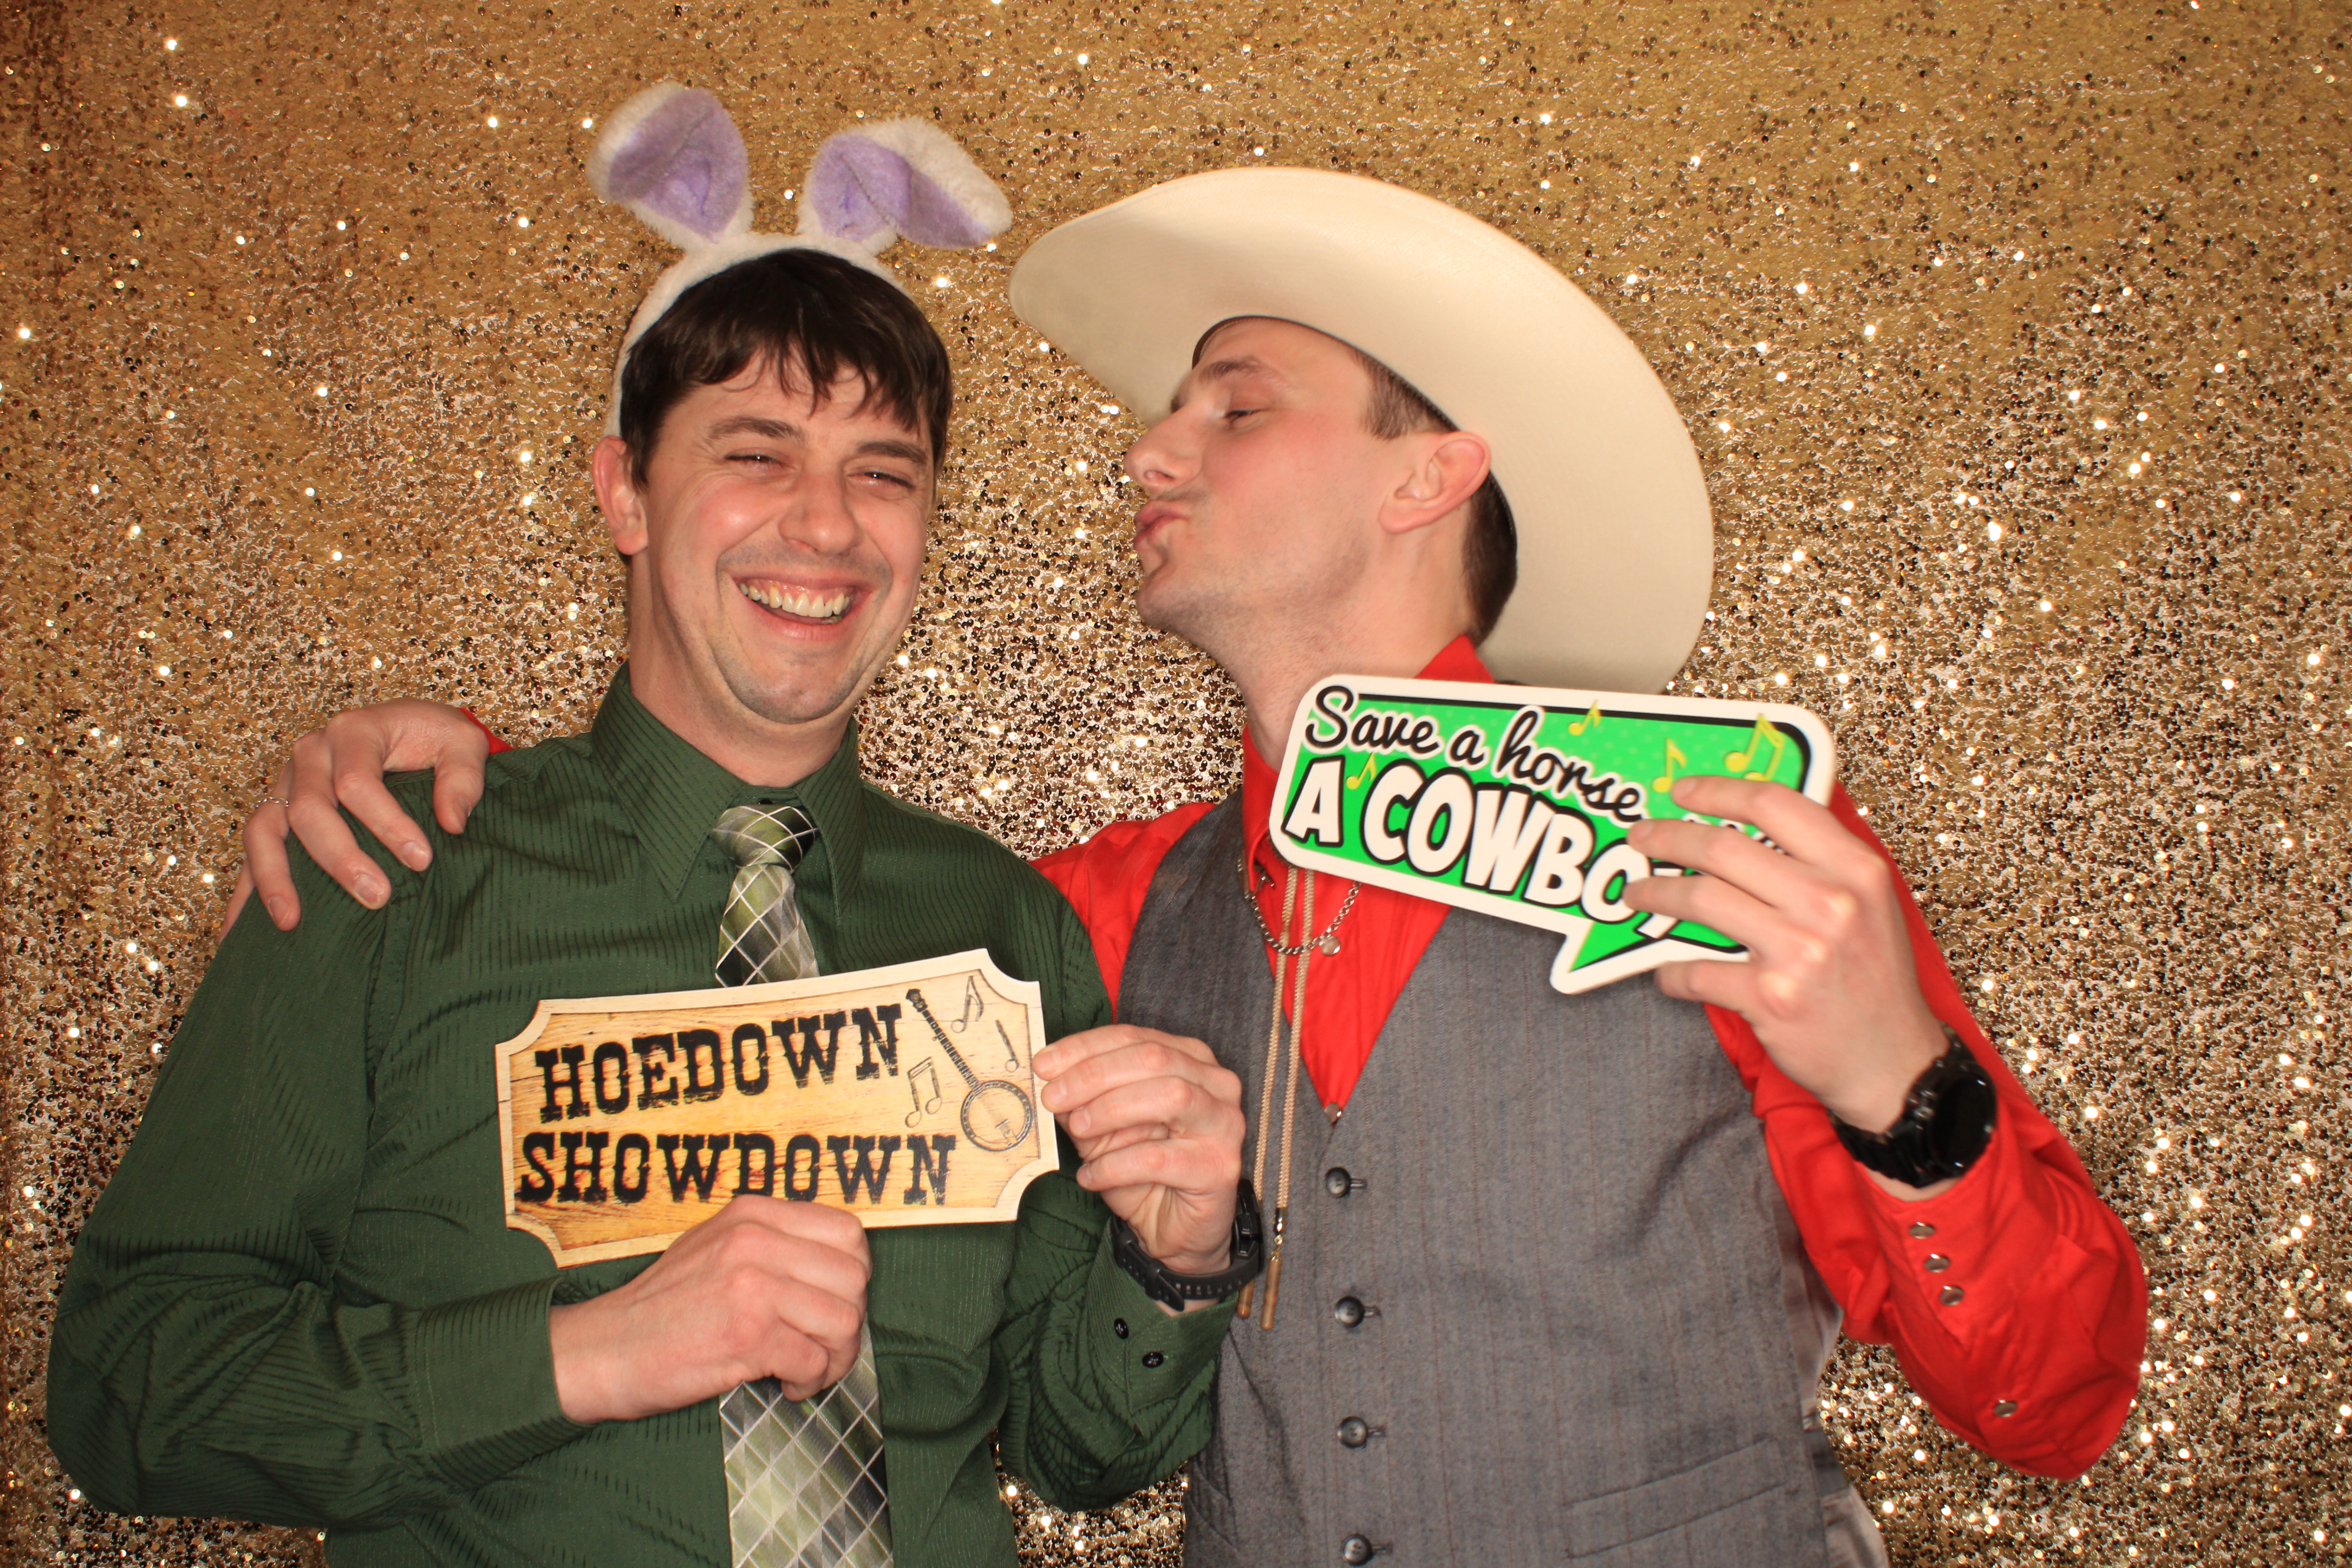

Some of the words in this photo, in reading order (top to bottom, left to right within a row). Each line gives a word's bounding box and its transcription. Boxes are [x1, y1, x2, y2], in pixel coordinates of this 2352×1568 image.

[1280, 754, 1345, 848] A
[1305, 685, 1440, 754] Save
[1449, 730, 1485, 766] a
[1496, 710, 1643, 822] horse
[535, 1002, 903, 1124] HOEDOWN
[520, 1131, 957, 1206] SHOWDOWN
